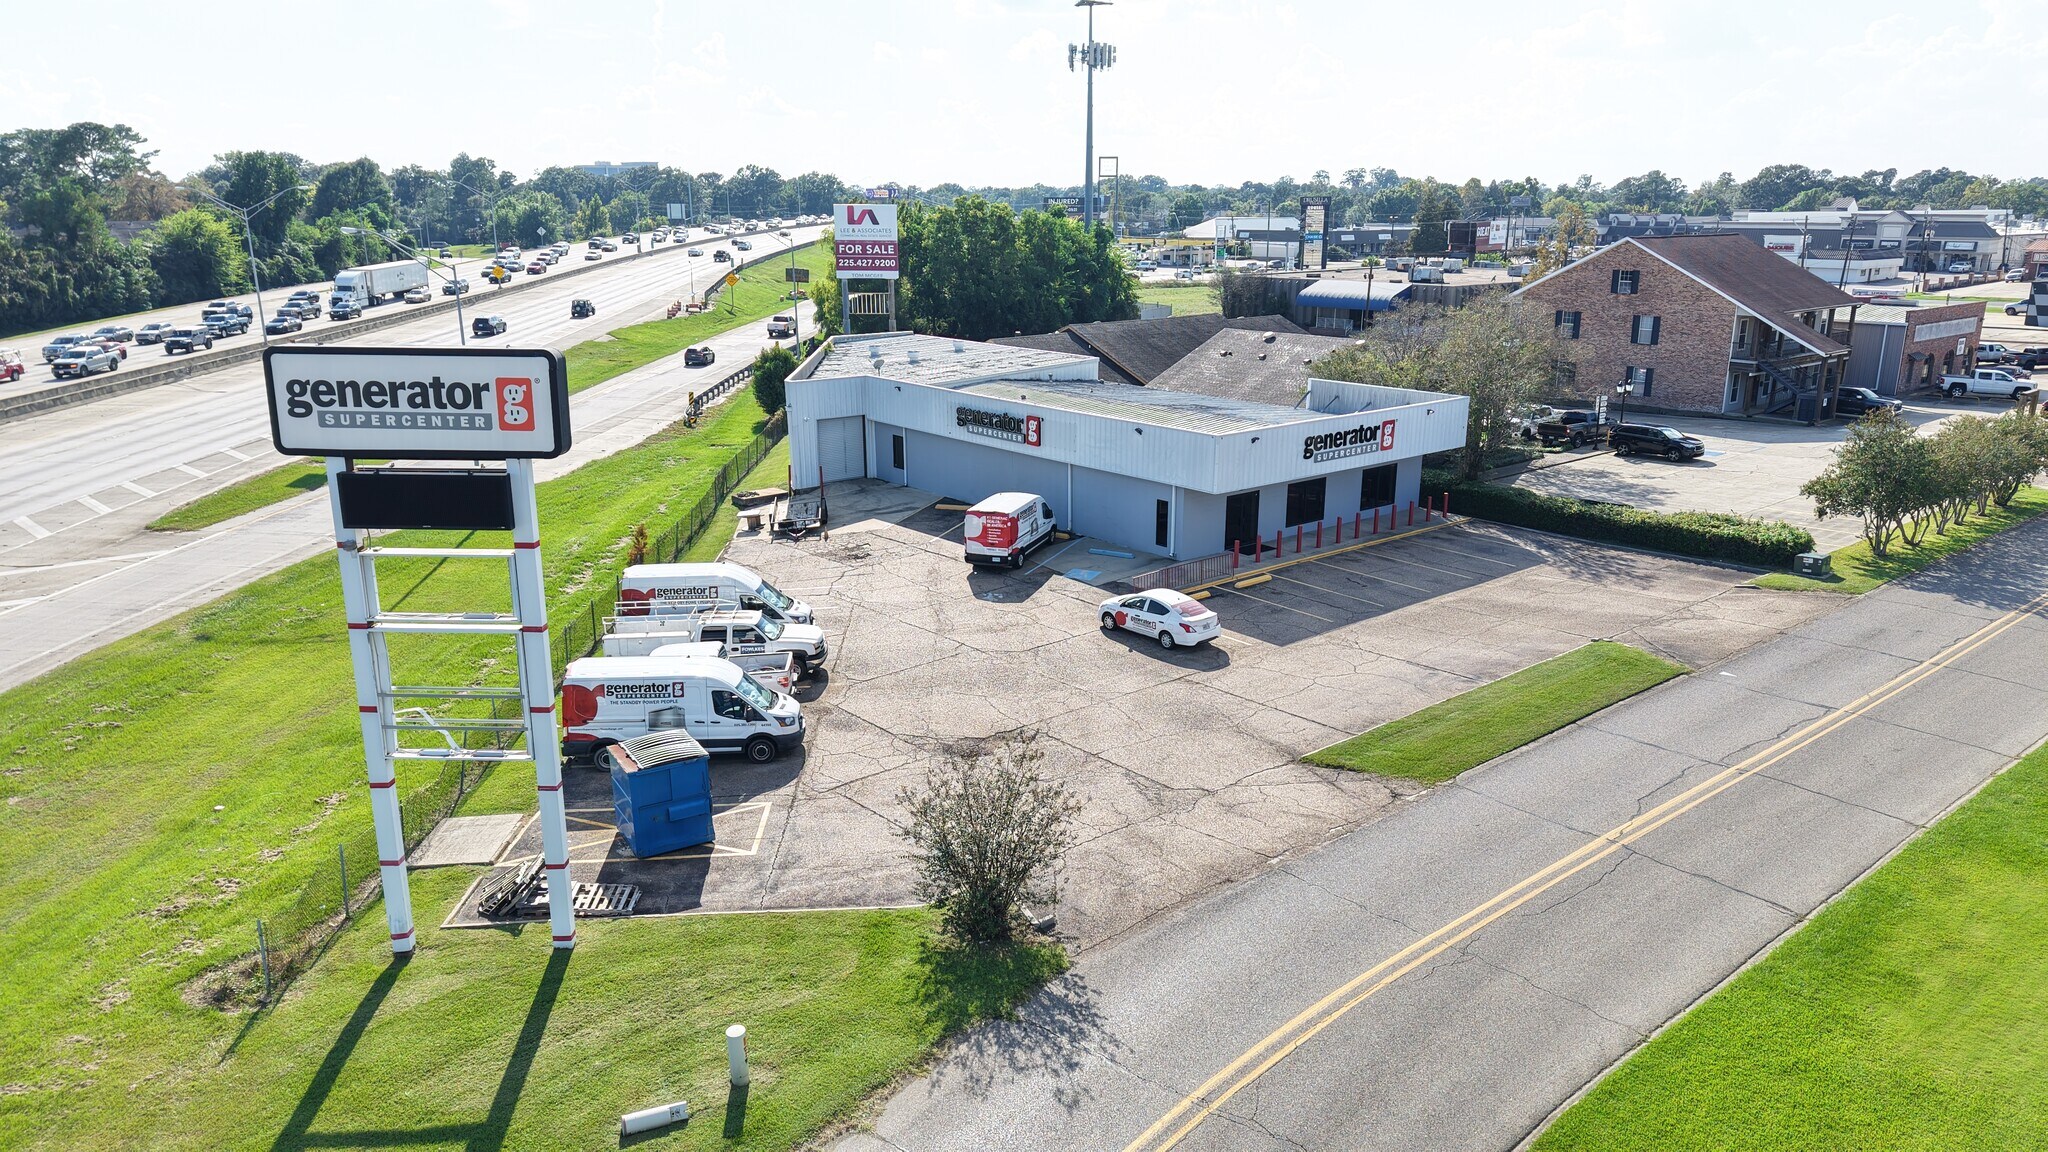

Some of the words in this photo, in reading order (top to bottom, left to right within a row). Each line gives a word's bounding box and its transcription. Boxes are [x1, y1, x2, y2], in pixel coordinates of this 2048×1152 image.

[839, 245, 863, 254] FOR
[866, 245, 895, 254] SALE
[838, 259, 896, 267] 225.427.9200
[286, 376, 490, 419] generator
[324, 413, 486, 428] SUPERCENTER
[956, 406, 1025, 433] generator
[968, 425, 1023, 442] SUPERCENTER
[1303, 424, 1381, 460] generator
[1317, 444, 1377, 461] SUPERCENTER
[656, 586, 708, 598] generator
[606, 683, 671, 697] generator
